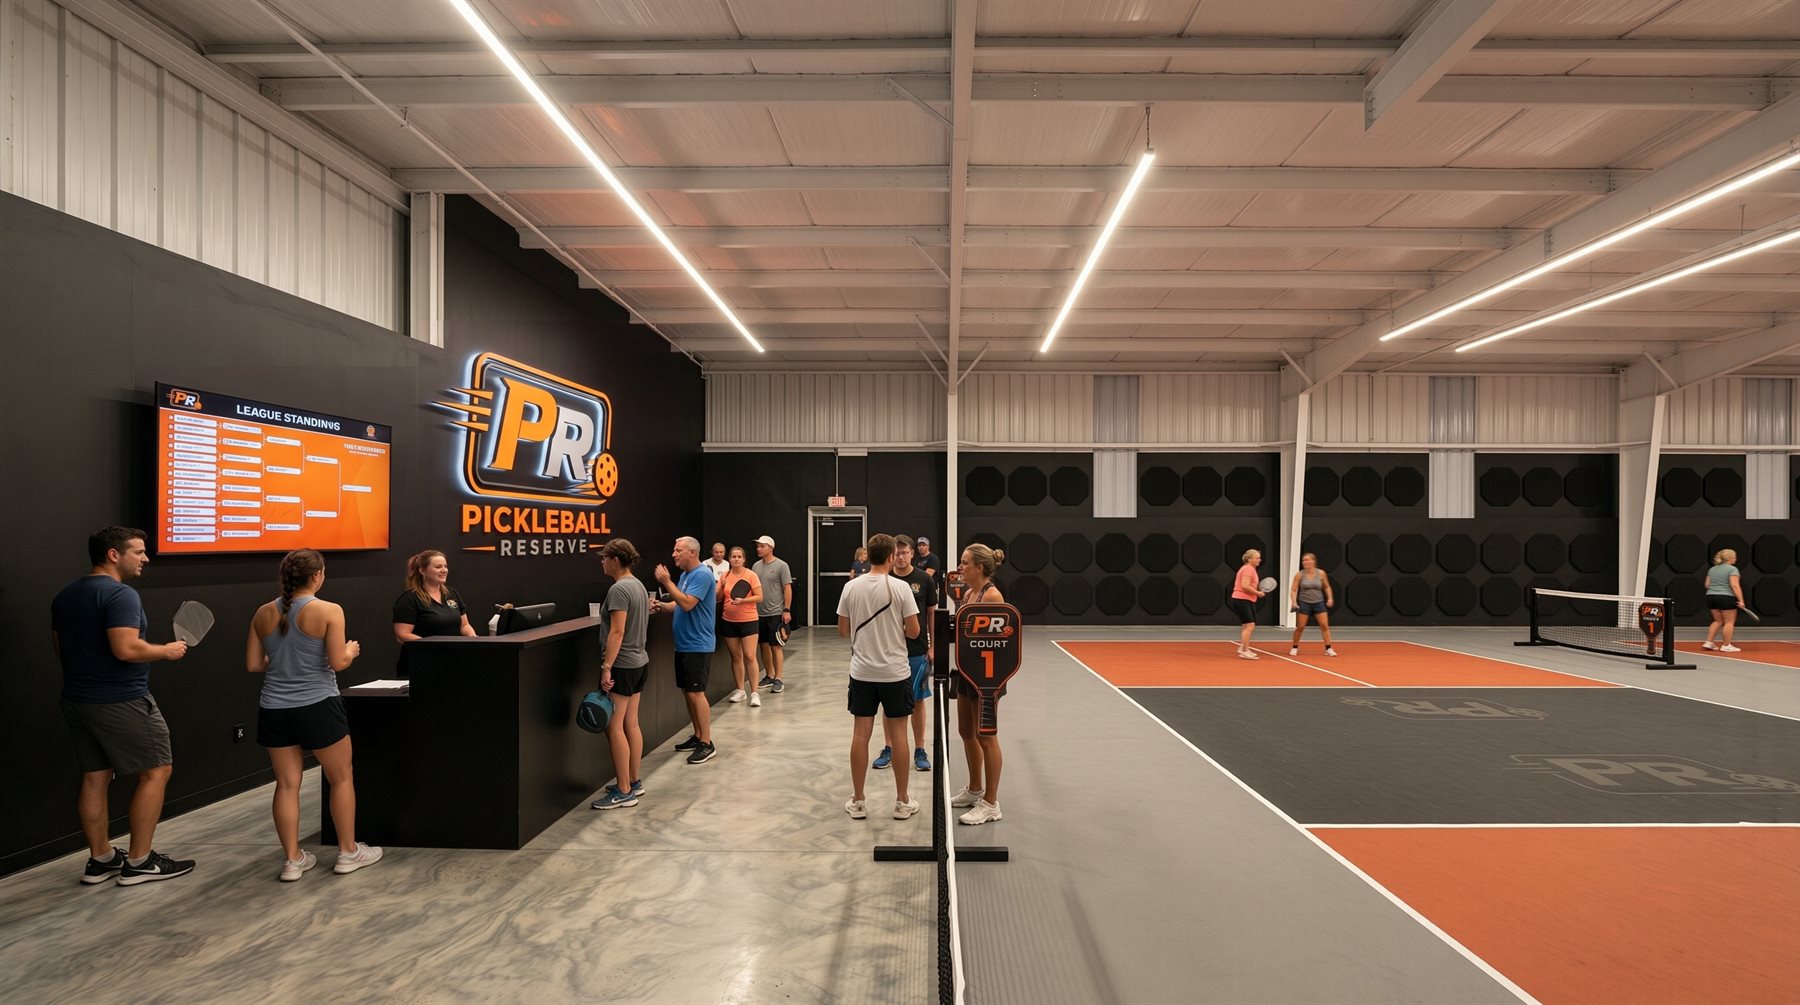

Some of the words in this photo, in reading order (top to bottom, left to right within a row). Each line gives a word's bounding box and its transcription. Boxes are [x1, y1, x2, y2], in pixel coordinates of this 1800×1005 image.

[174, 391, 196, 407] PR
[236, 404, 282, 421] LEAGUE
[489, 377, 595, 480] PR
[462, 503, 611, 534] PICKLEBALL
[500, 538, 587, 556] RESERVE
[972, 616, 1005, 633] PR
[1648, 622, 1655, 633] 1
[969, 640, 1008, 648] COURT
[981, 651, 994, 678] 1
[1544, 757, 1734, 787] PR
